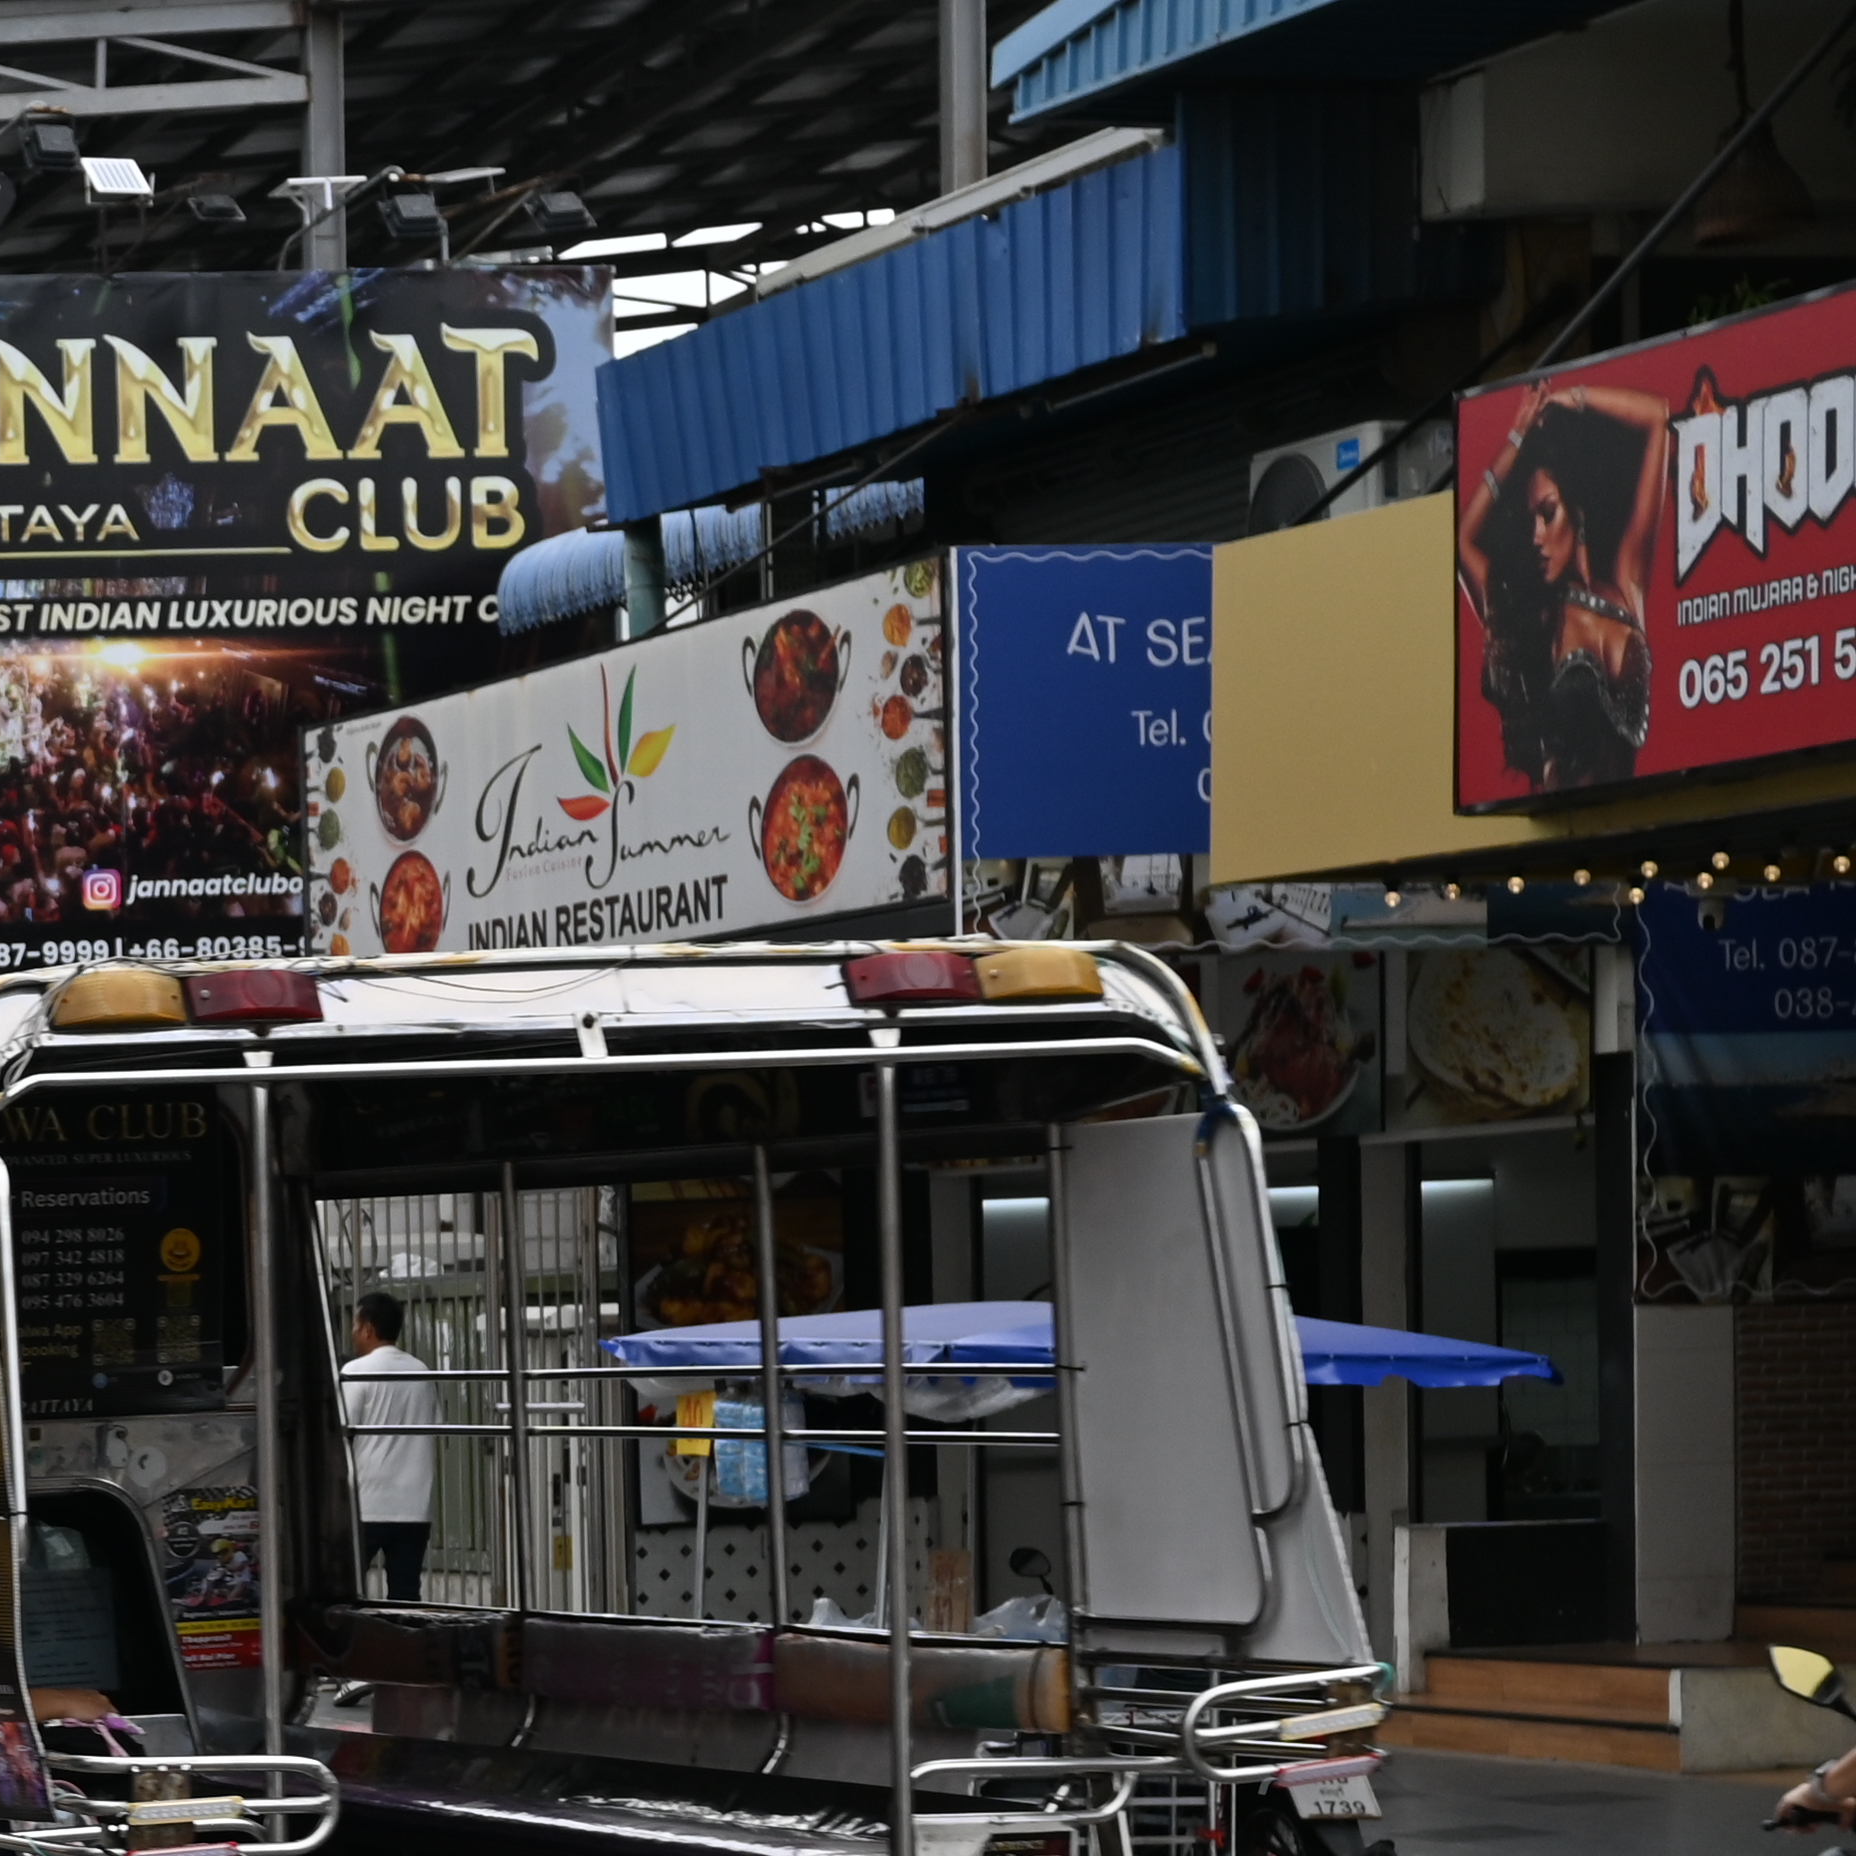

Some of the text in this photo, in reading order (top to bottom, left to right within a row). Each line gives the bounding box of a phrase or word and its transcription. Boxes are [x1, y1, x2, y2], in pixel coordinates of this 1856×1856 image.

[290, 476, 525, 551] CLUB
[39, 601, 160, 634] INDIAN
[168, 597, 356, 629] LUXURIOUS
[366, 594, 470, 626] NIGHT
[1678, 592, 1730, 626] INDIAN
[1807, 573, 1820, 599] &
[1823, 564, 1856, 597] NIGH
[1067, 612, 1213, 669] AT SE
[1679, 650, 1749, 709] 065
[1760, 635, 1821, 695] 251
[1132, 710, 1188, 748] Tel.
[468, 744, 731, 898] Indian Summer
[469, 873, 729, 949] INDIAN RESTAURANT
[1718, 935, 1856, 972] Tel. 087-
[1773, 986, 1856, 1019] 038-
[89, 1101, 208, 1141] CLUB
[21, 1187, 151, 1209] Reservations
[54, 1228, 83, 1245] 298
[1313, 1800, 1366, 1815] 1739
